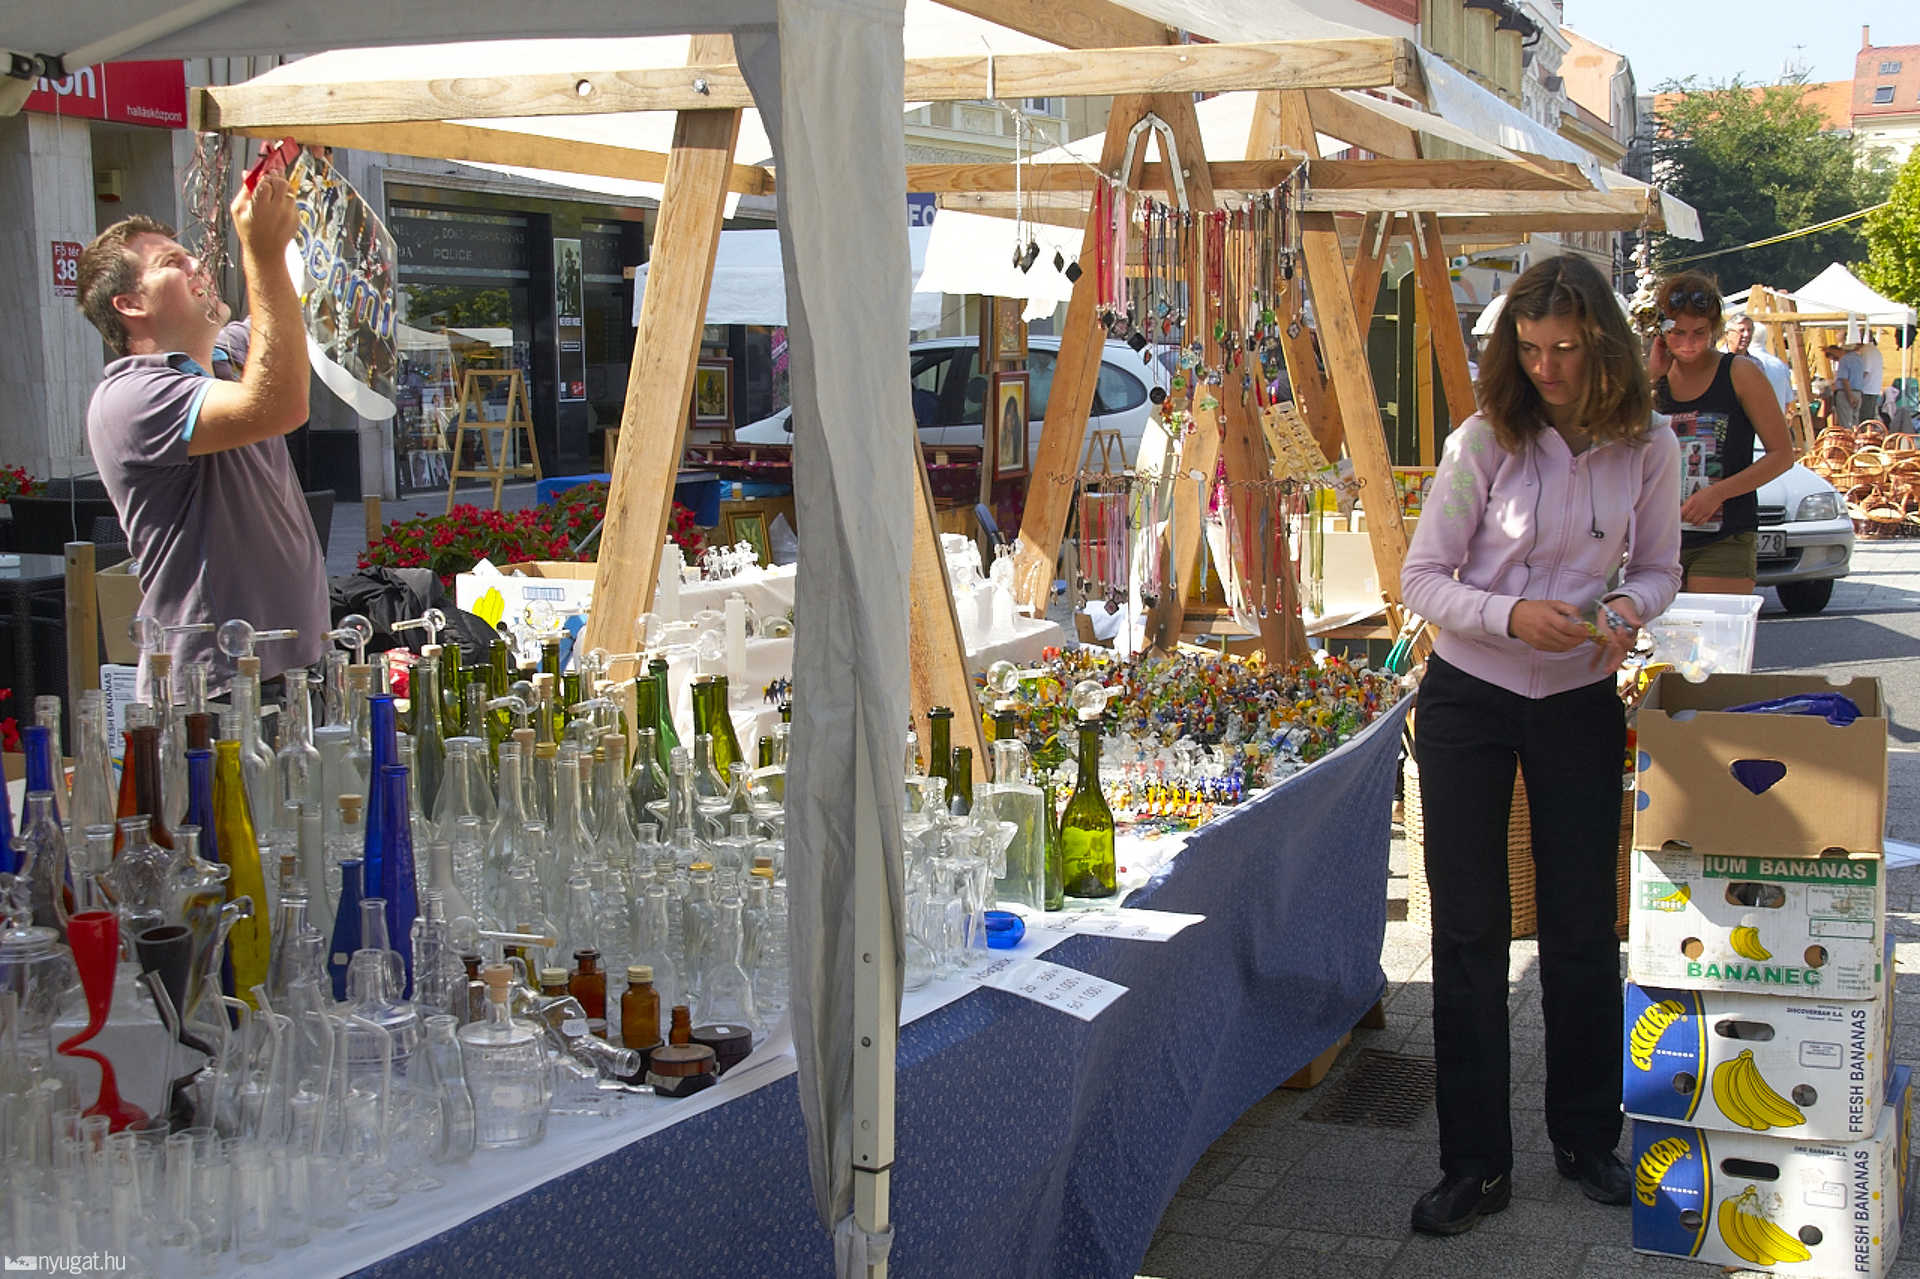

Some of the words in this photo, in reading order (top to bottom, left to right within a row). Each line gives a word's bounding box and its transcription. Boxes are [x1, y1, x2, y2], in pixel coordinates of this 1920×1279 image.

[57, 258, 78, 281] 38
[104, 672, 116, 716] BANANAS
[1704, 856, 1748, 874] IUM
[1759, 859, 1868, 880] BANANAS
[1849, 1009, 1867, 1082] BANANAS
[1849, 1086, 1865, 1134] FRESH
[1854, 1149, 1870, 1221] BANANAS
[1854, 1224, 1870, 1273] FRESH
